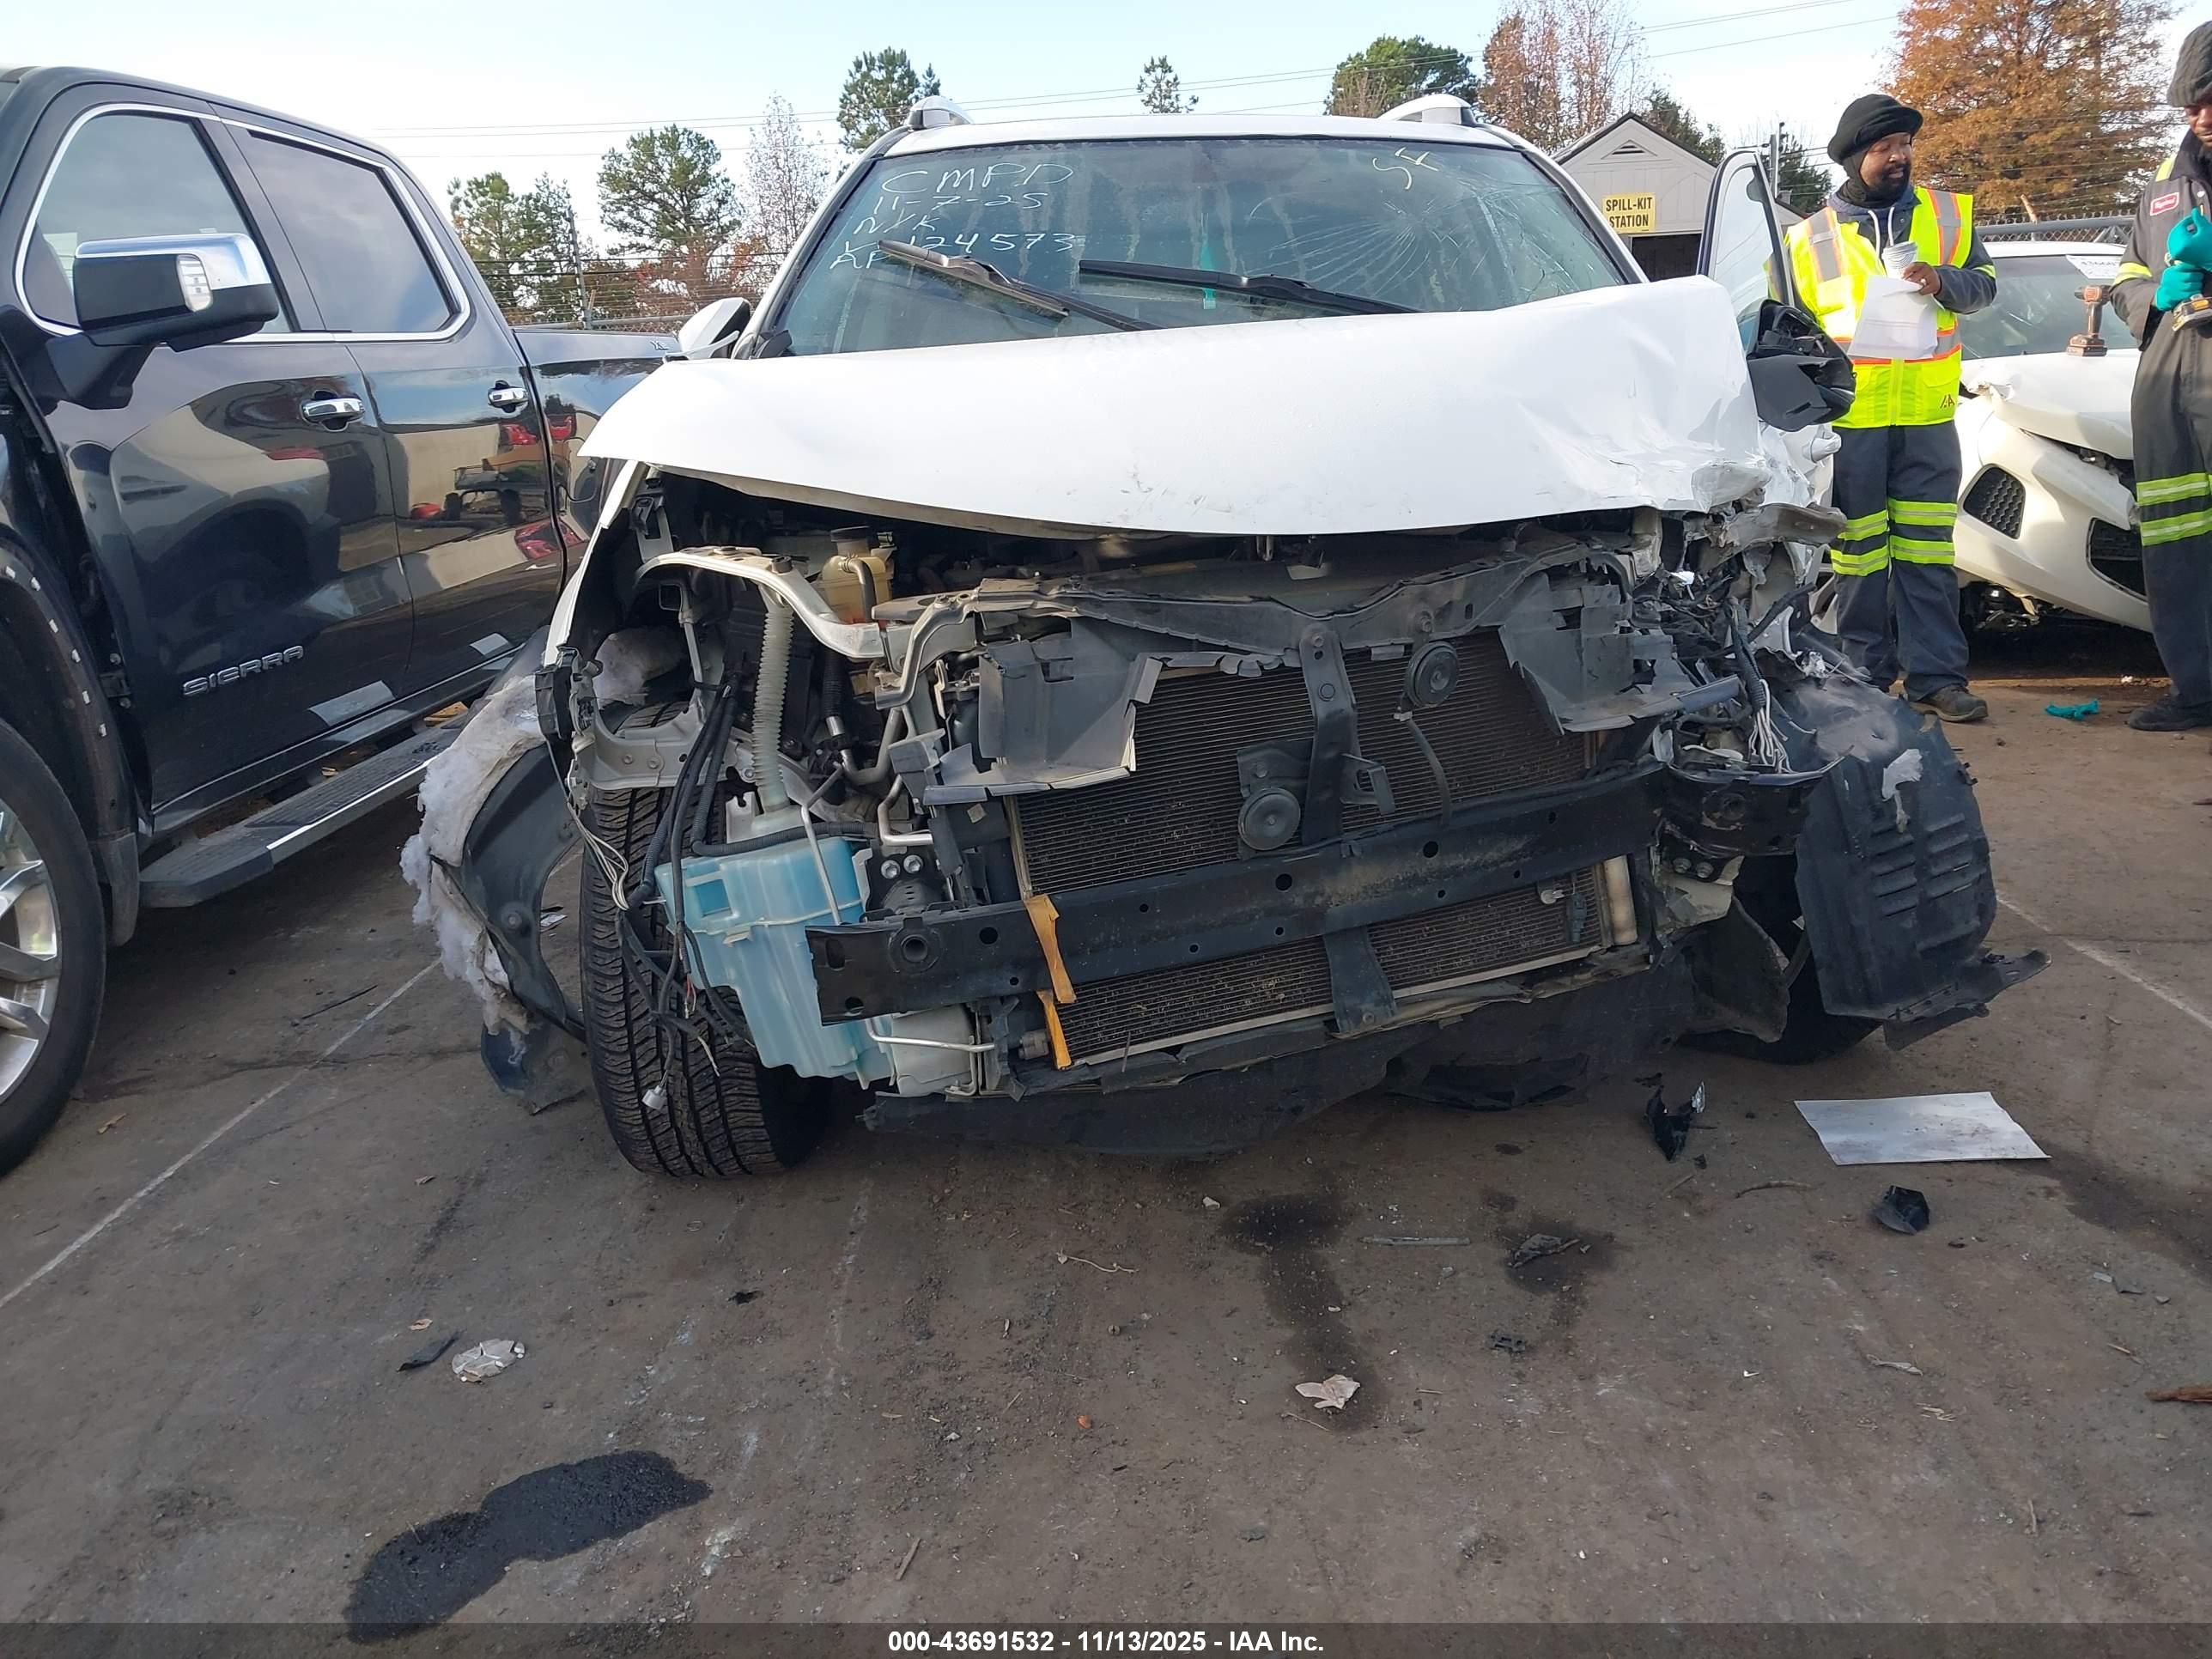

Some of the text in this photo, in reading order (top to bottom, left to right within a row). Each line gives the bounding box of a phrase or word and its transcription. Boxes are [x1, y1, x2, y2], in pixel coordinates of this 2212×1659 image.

[881, 162, 1073, 193] CMPD
[873, 192, 1048, 215] 11-7-25
[1605, 197, 1653, 212] SPILL-KIT
[1608, 214, 1649, 228] STATION
[182, 645, 304, 696] SIERRA
